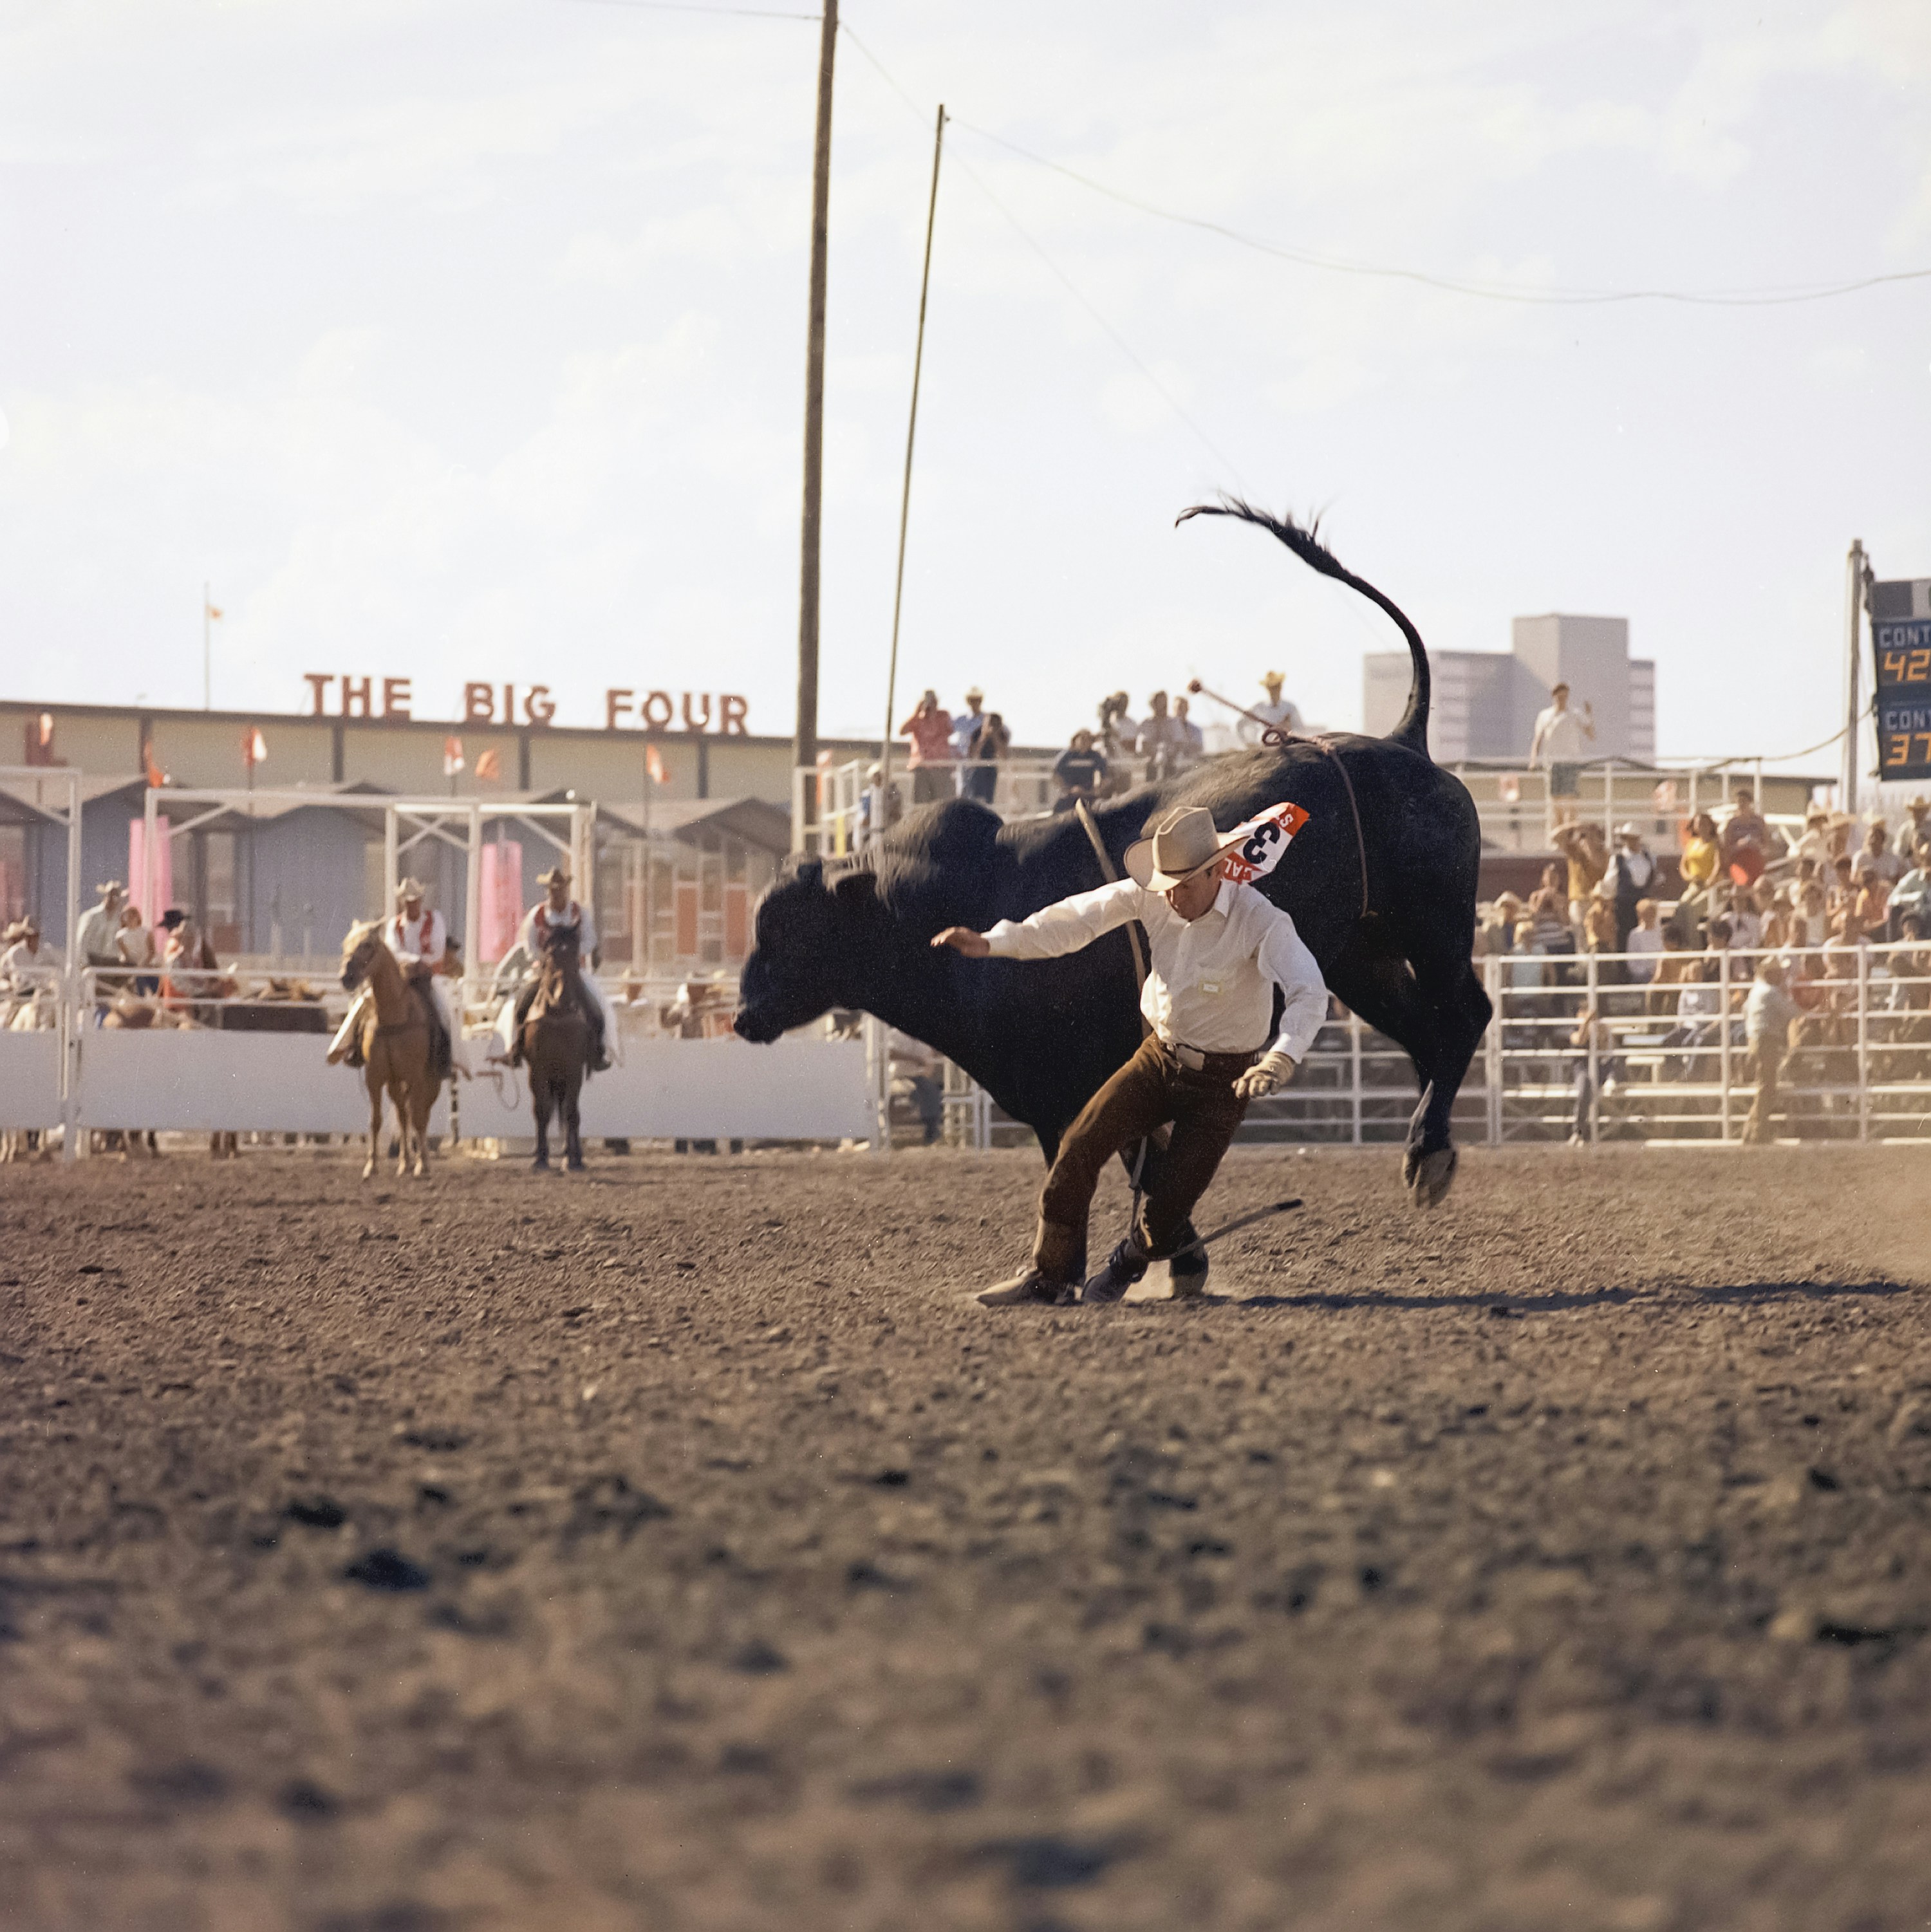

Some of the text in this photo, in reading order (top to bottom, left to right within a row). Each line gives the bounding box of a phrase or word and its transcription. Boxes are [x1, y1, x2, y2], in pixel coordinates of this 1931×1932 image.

[1884, 649, 1931, 682] 42
[304, 674, 749, 734] THE BIG FOUR
[1885, 709, 1931, 730] CON
[1242, 821, 1280, 864] 3
